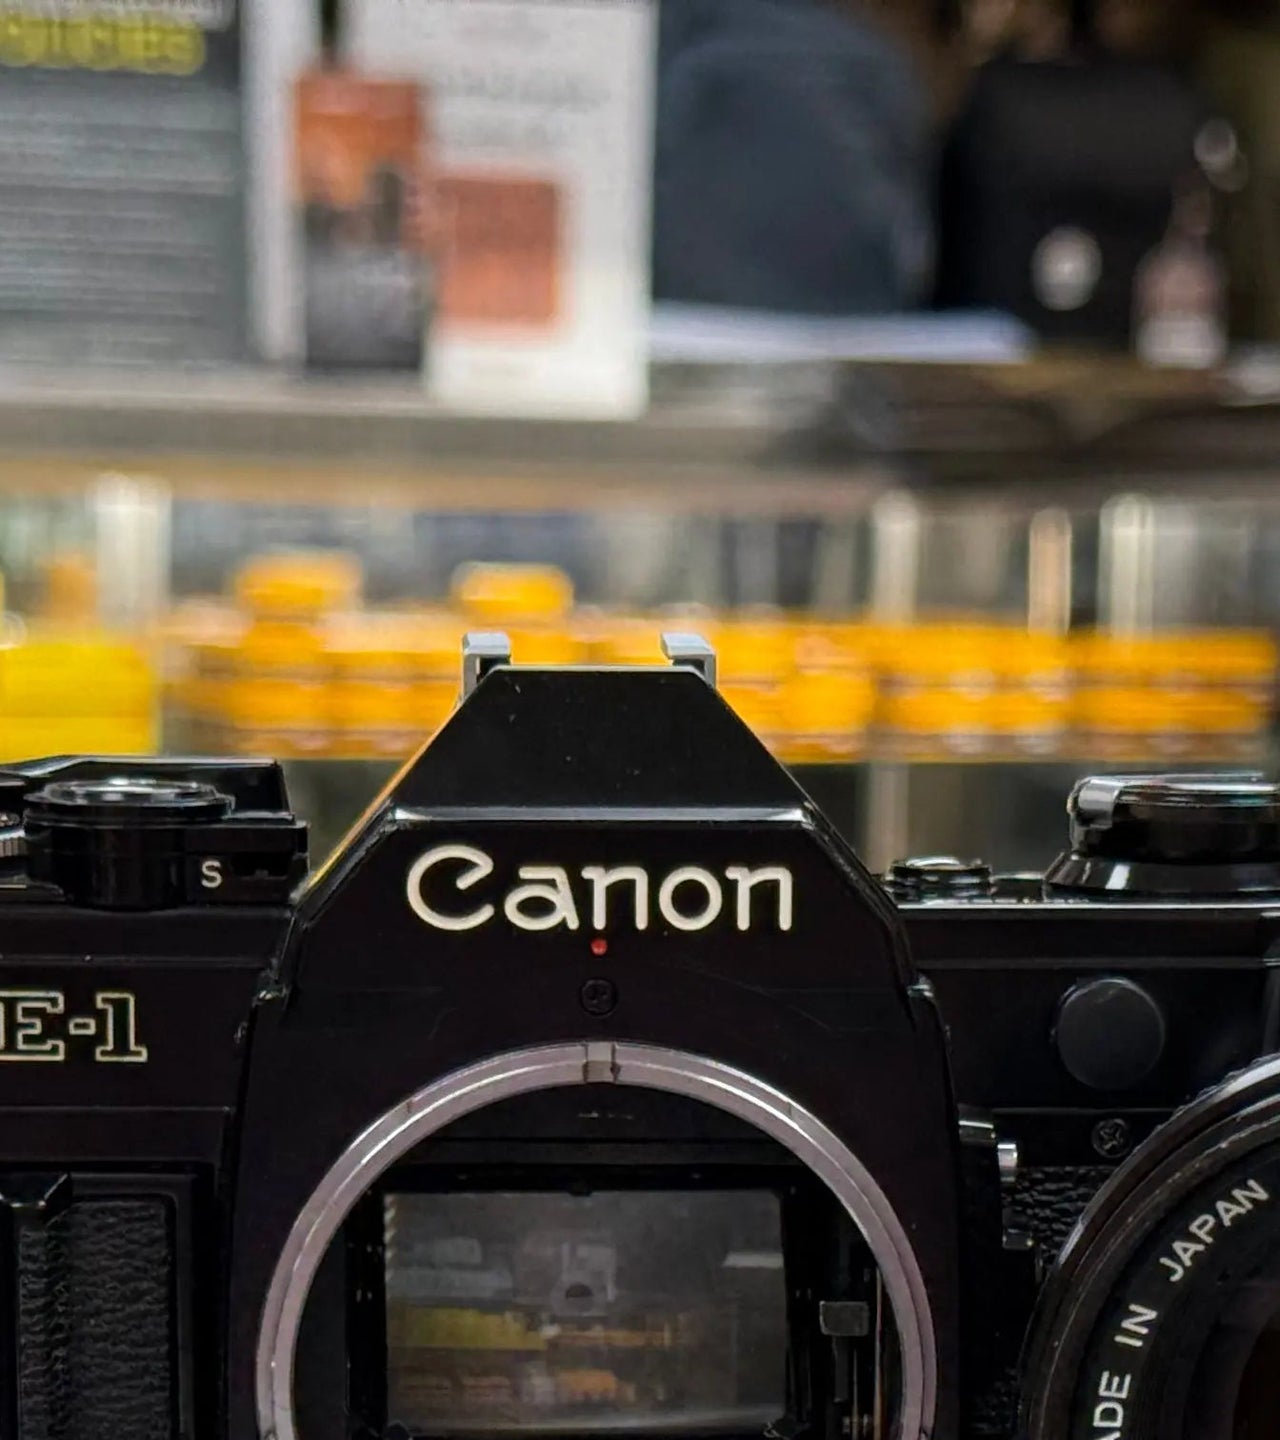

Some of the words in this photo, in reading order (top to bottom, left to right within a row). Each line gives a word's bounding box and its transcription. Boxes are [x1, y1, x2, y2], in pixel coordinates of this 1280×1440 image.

[201, 860, 222, 888] S
[406, 844, 793, 931] Canon
[1114, 1303, 1157, 1347] IN
[1158, 1178, 1269, 1283] JAPAN
